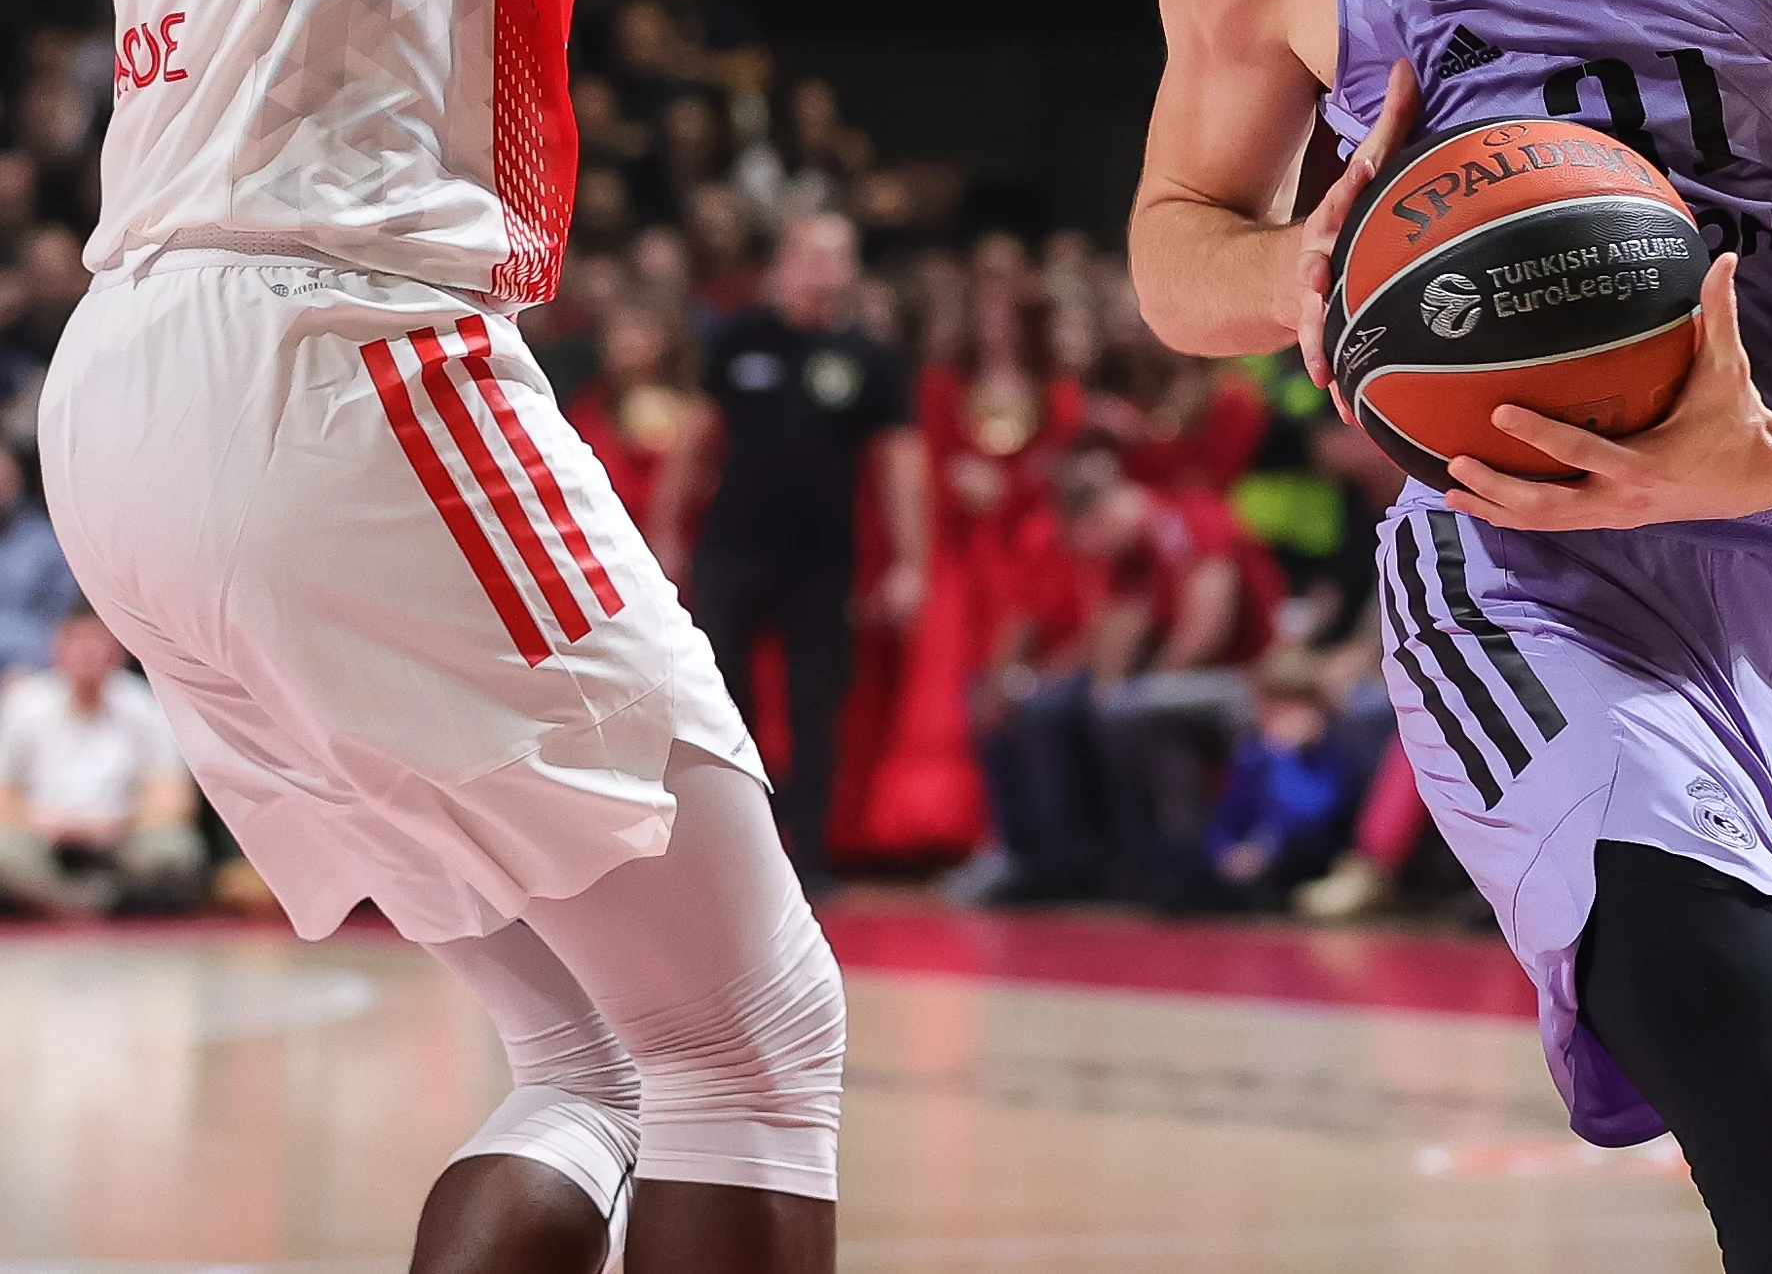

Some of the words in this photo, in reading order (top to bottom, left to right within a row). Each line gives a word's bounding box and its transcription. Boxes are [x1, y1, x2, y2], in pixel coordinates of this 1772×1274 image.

[1438, 45, 1505, 80] adidas
[1391, 138, 1653, 244] SPALDING
[1485, 246, 1601, 289] TURKISH
[1607, 236, 1690, 266] AIRLINES
[1492, 266, 1661, 319] EuroLeague
